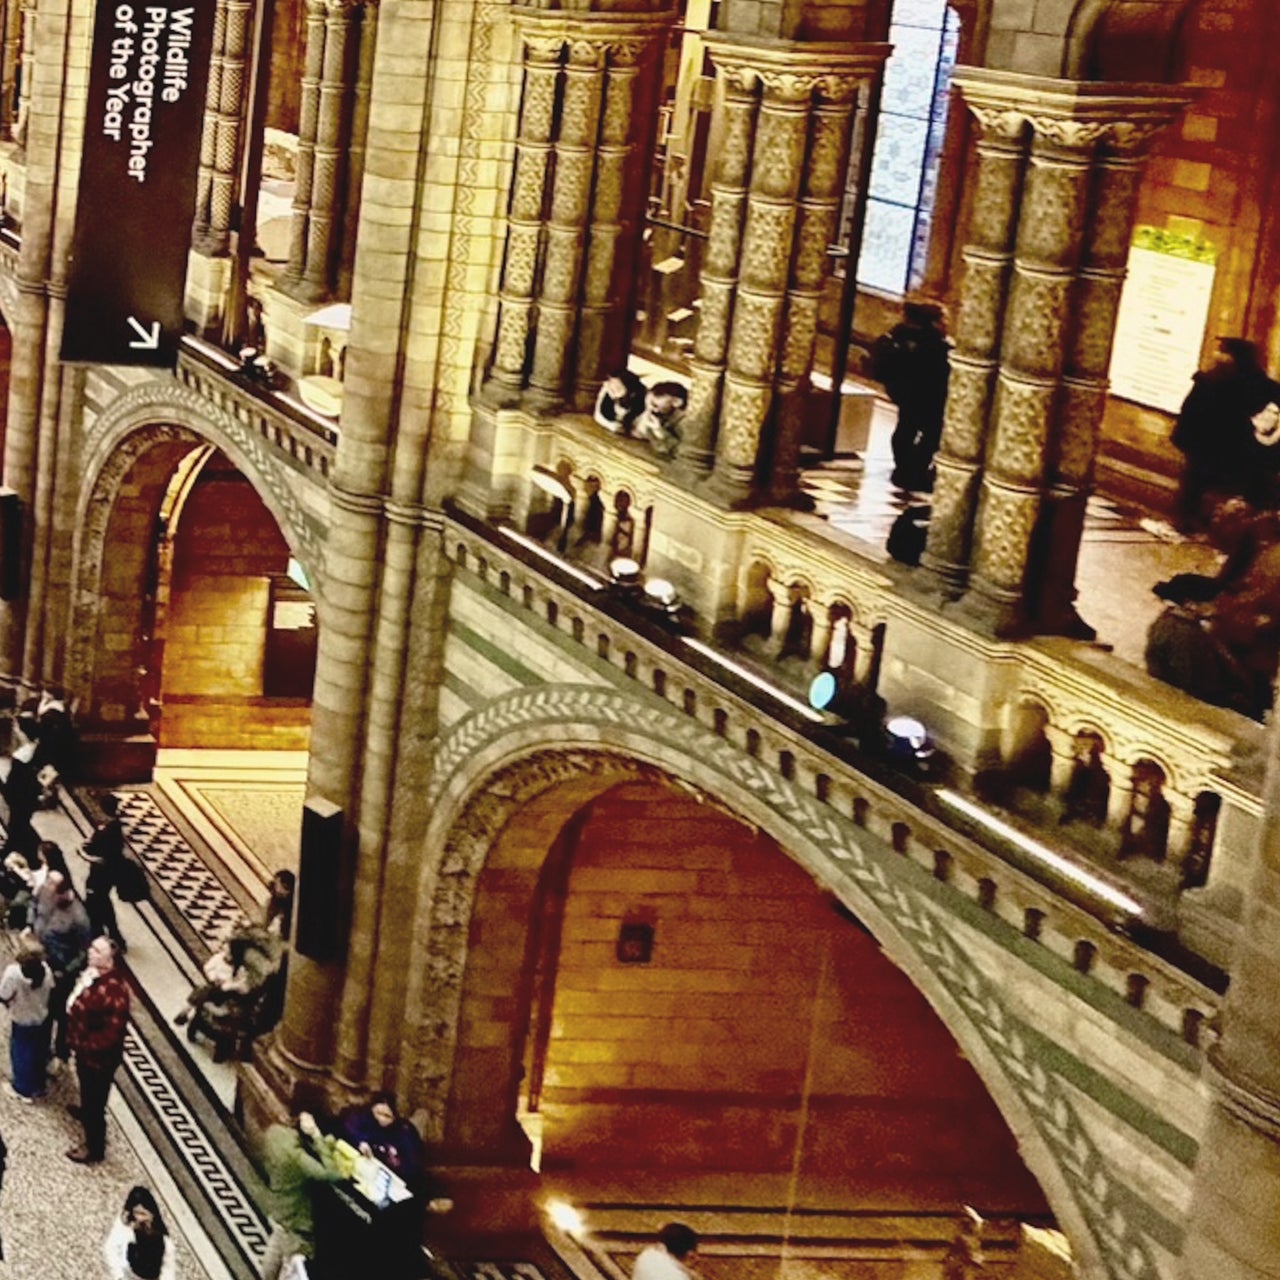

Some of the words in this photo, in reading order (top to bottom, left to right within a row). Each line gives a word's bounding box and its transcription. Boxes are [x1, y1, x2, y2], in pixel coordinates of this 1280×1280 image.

[114, 4, 139, 34] of
[109, 37, 135, 79] the
[161, 7, 195, 103] Wildlife
[103, 82, 131, 141] Year
[127, 7, 168, 183] Photographer
